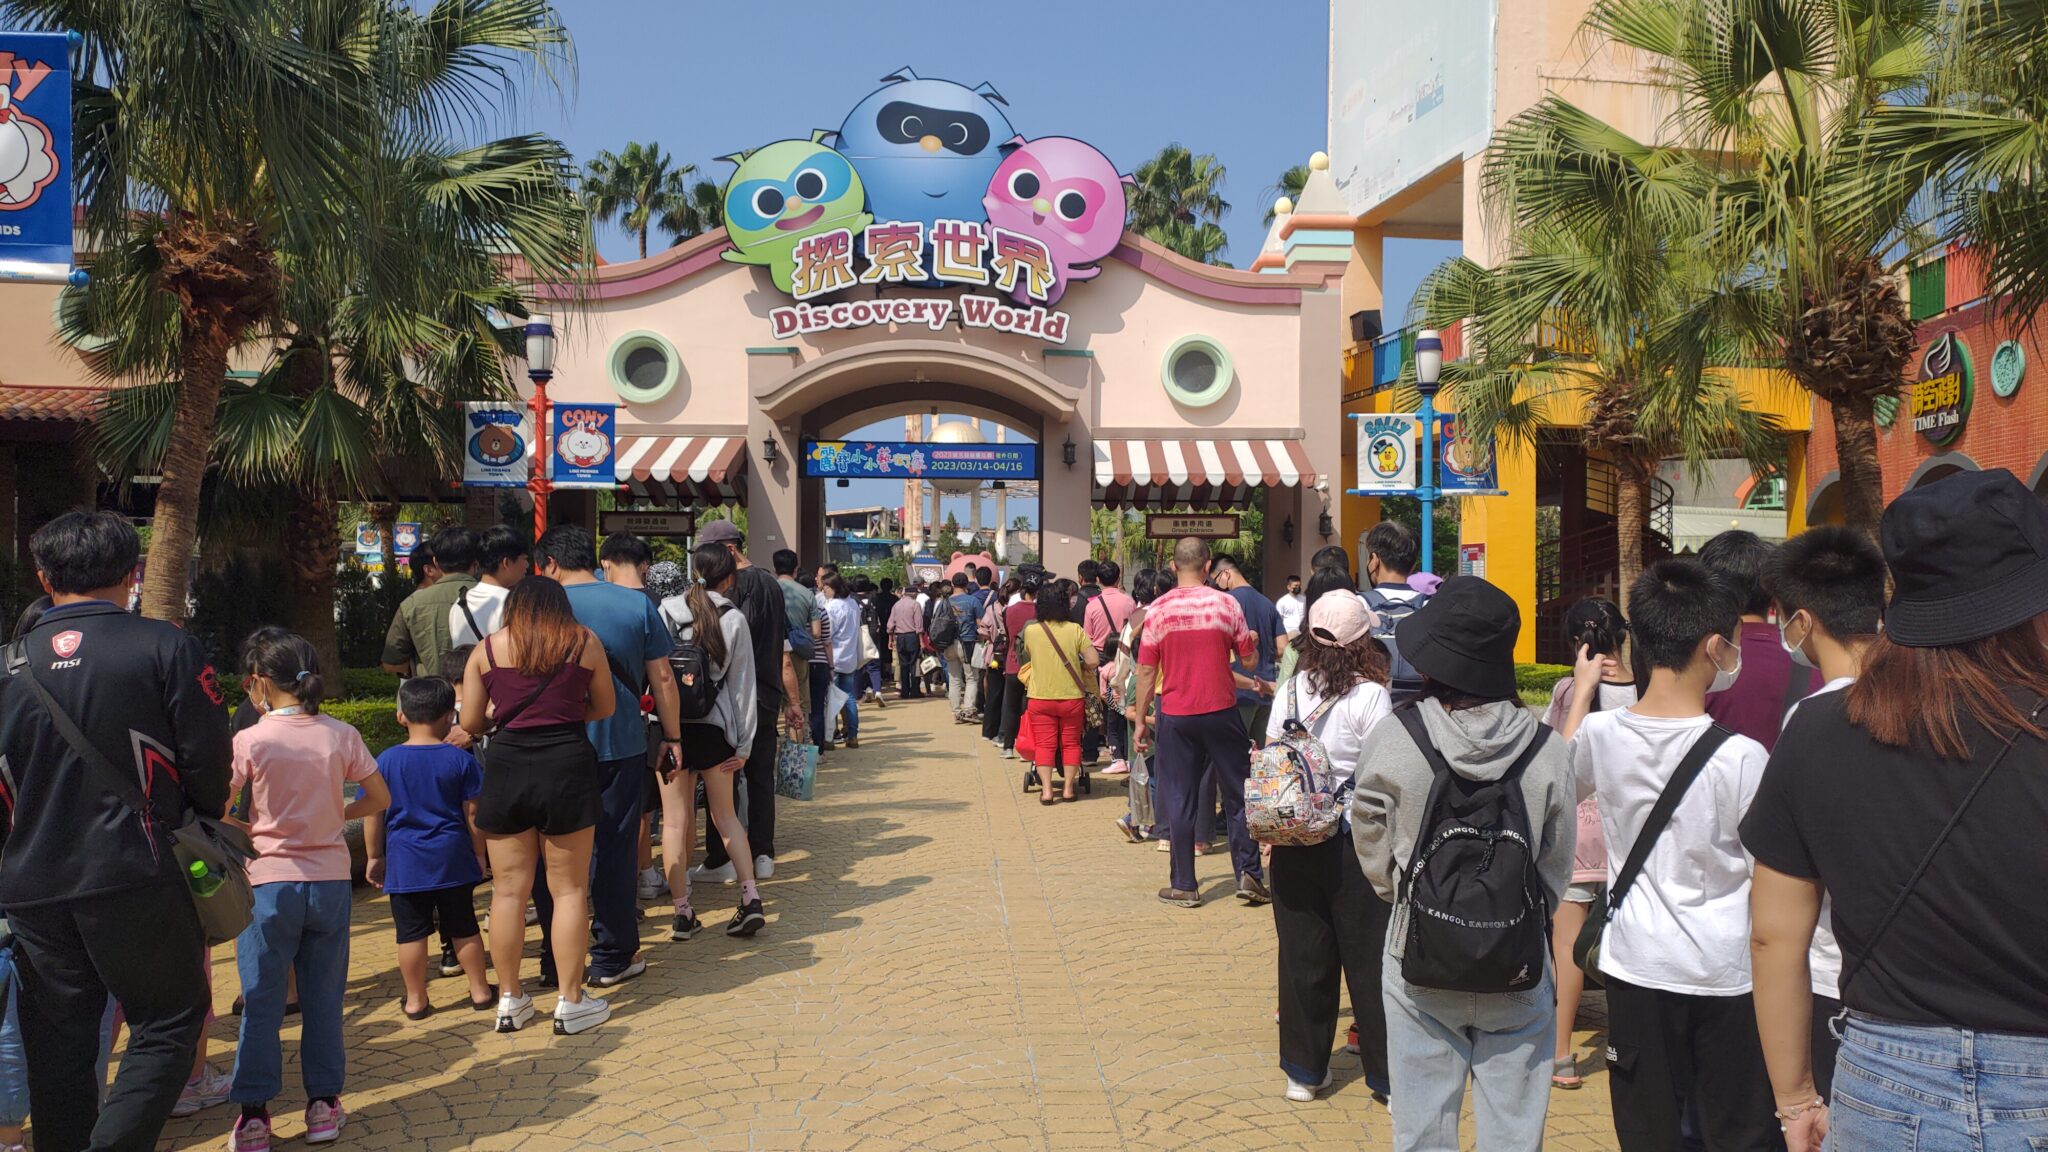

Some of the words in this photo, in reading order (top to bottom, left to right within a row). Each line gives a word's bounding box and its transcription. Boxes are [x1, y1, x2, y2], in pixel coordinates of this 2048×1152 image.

[792, 220, 1055, 299] 探索世界
[771, 299, 950, 337] Discovery
[962, 297, 1069, 341] World
[561, 408, 609, 428] CONY
[1364, 415, 1411, 438] SALLY
[1913, 414, 1937, 432] TIME
[1938, 409, 1960, 427] Flash
[931, 461, 1023, 472] 2023/03/14-04/16
[50, 657, 82, 670] msi
[1442, 827, 1480, 839] KANGOL
[1427, 907, 1466, 927] KANGOL
